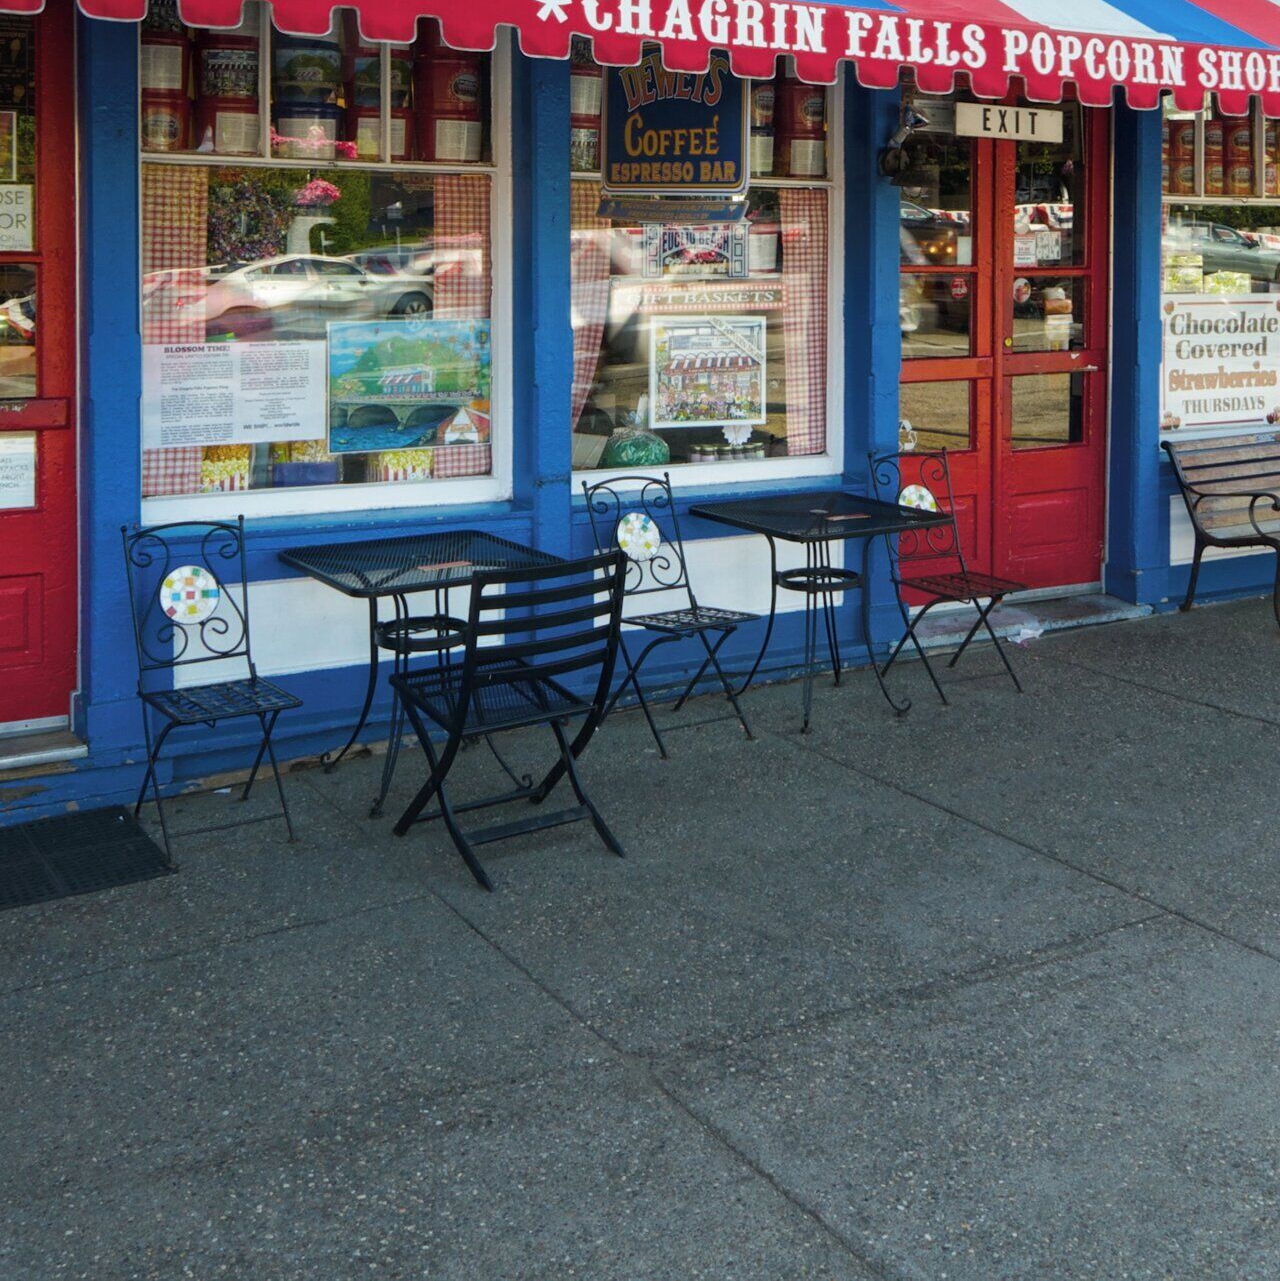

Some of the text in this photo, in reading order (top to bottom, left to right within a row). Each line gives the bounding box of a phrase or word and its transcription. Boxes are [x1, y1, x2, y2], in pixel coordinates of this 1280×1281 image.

[843, 10, 987, 69] FALLS
[1001, 28, 1186, 87] POPCORN
[982, 107, 1038, 135] EXIT
[623, 112, 719, 157] COFFEE
[610, 160, 736, 183] ESPRESSO BAR
[683, 290, 775, 303] BASKETS
[1169, 311, 1279, 336] Chocolate
[164, 345, 205, 354] BLOSSOM
[1175, 336, 1268, 360] Covered
[1168, 361, 1278, 392] Strawberries
[1181, 395, 1266, 415] THURSDAYS
